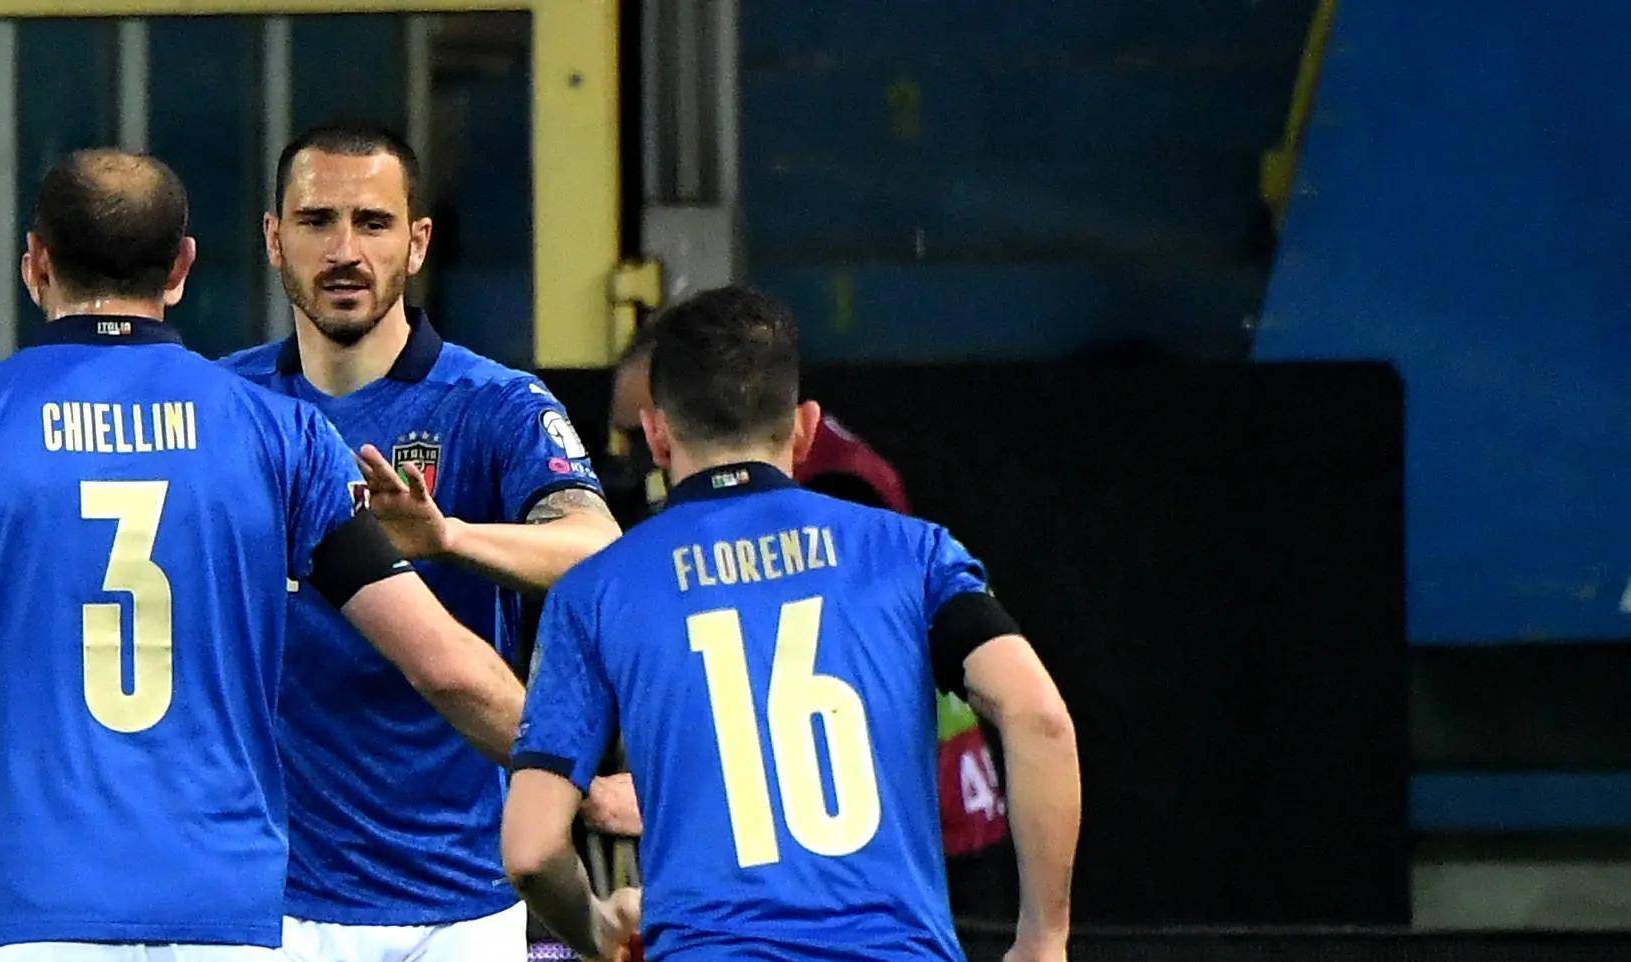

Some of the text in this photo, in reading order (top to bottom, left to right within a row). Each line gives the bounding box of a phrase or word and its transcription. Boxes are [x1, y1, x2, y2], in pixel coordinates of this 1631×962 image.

[41, 401, 198, 453] CHIELLINI
[396, 448, 437, 460] ITALIA
[672, 525, 838, 593] FLORENZI
[79, 480, 173, 733] 3
[686, 595, 882, 868] 16
